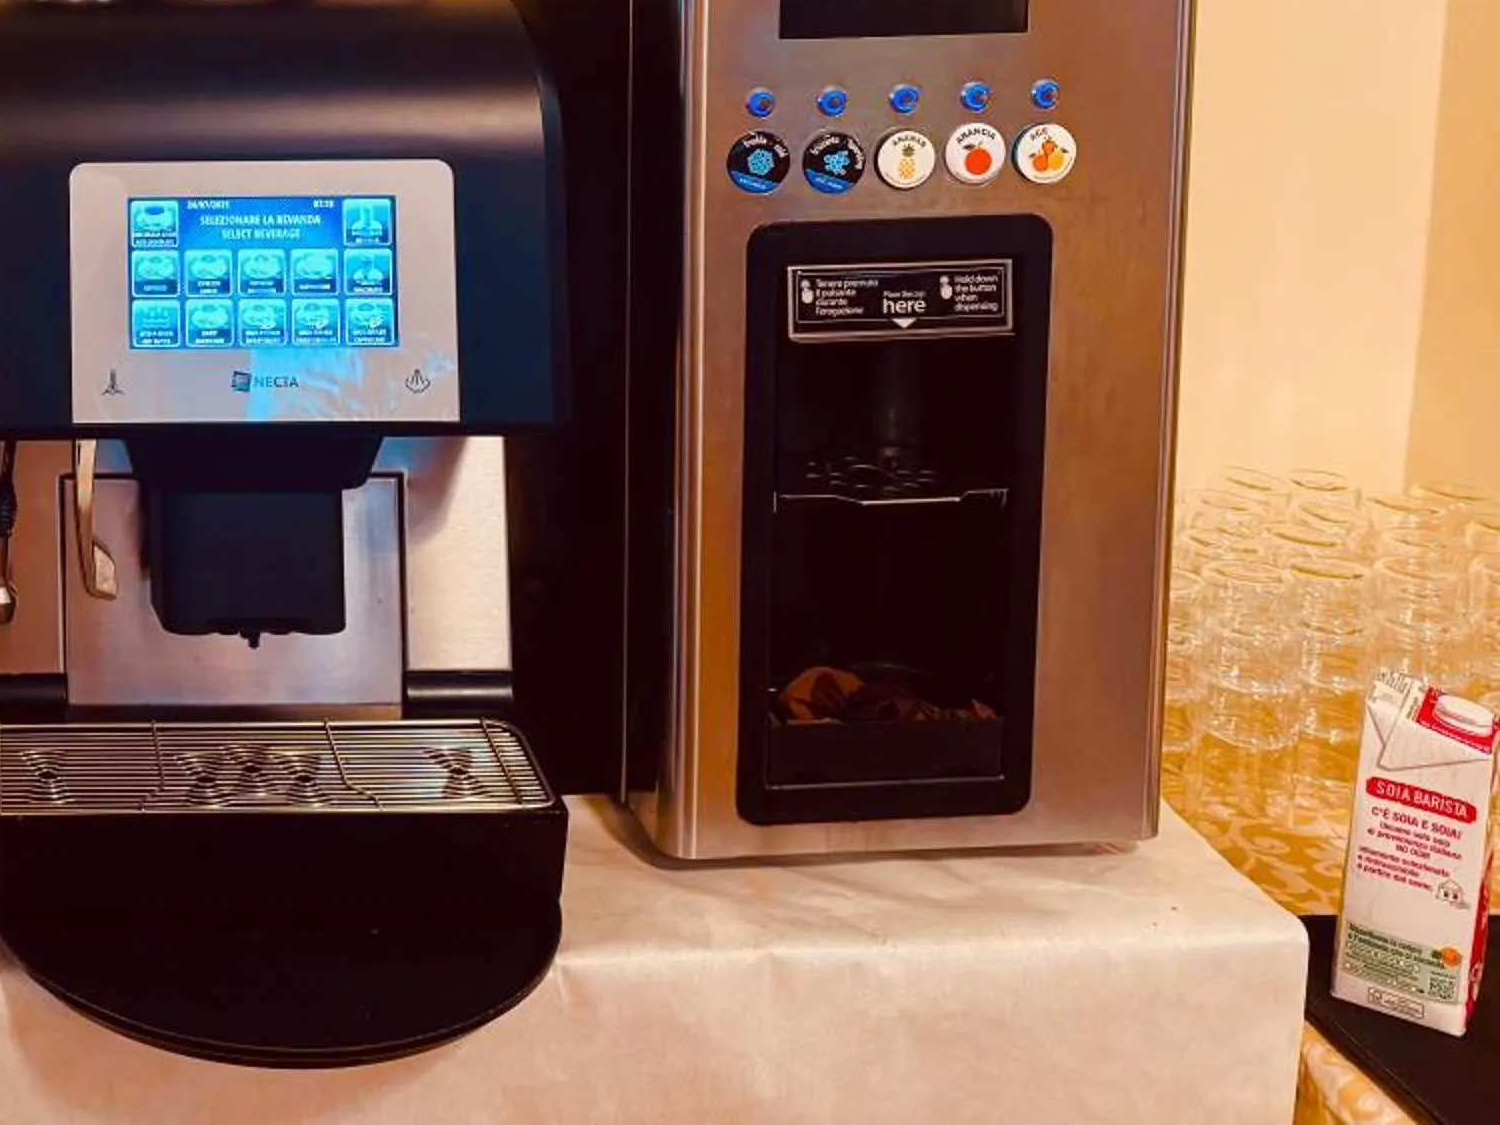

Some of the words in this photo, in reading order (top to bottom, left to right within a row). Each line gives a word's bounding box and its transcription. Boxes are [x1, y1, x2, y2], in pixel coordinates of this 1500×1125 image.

[956, 128, 996, 145] ARANCIA
[200, 214, 261, 226] SELEZIONARE
[263, 214, 275, 225] LA
[276, 213, 321, 225] BEVANDA
[221, 228, 251, 240] SELECT
[253, 227, 300, 239] BEVERAGE
[975, 274, 999, 283] down
[969, 284, 997, 293] button
[954, 293, 978, 302] when
[883, 298, 927, 314] here
[253, 376, 300, 388] NECTA
[1376, 780, 1411, 802] SOIA
[1413, 791, 1468, 817] BARISTA
[1392, 812, 1419, 828] SOIA
